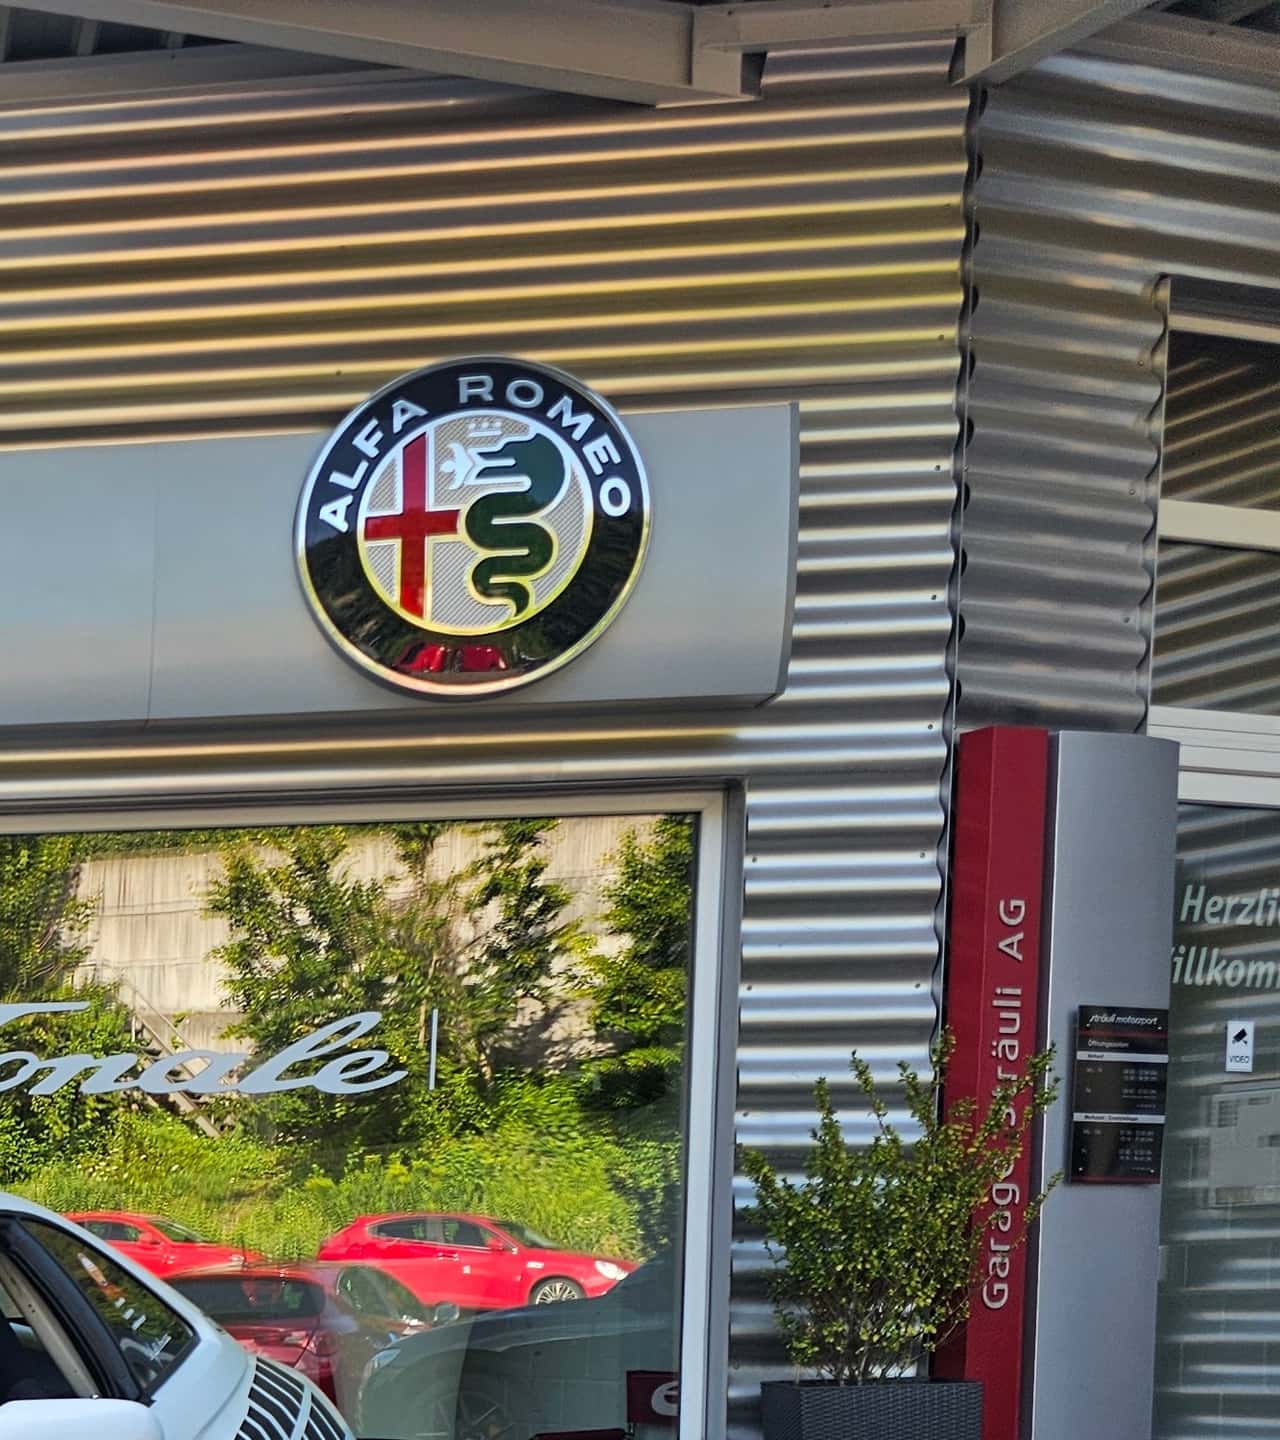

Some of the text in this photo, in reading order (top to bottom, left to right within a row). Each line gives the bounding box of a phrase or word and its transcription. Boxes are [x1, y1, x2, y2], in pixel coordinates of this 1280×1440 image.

[319, 375, 632, 533] ALFA ROMEO
[1180, 884, 1280, 928] Herzli
[998, 899, 1026, 962] AG
[1170, 945, 1280, 990] illkom
[1229, 1056, 1249, 1064] VIDEO
